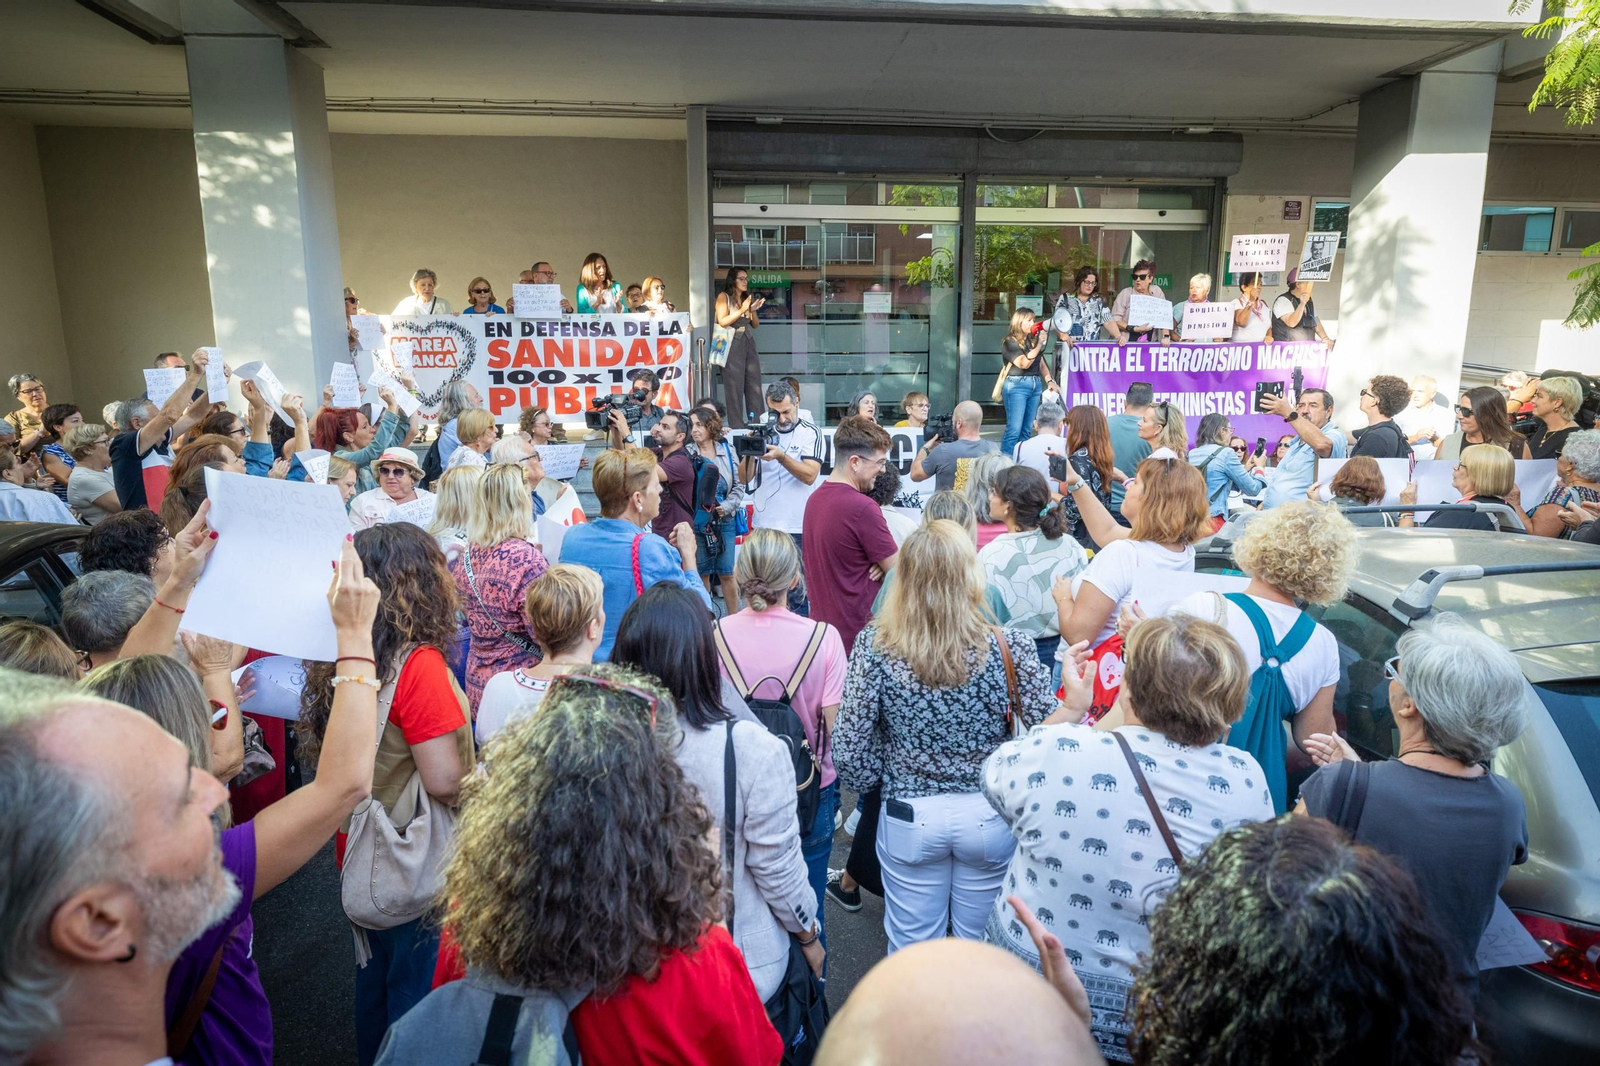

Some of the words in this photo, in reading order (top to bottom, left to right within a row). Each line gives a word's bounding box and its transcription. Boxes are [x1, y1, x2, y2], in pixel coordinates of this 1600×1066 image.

[751, 274, 782, 284] SALIDA
[1151, 277, 1169, 286] ADA
[484, 322, 513, 338] EN
[521, 321, 616, 337] DEFENSA
[624, 321, 651, 336] DE
[658, 320, 683, 335] LA
[392, 352, 458, 368] ANCA
[487, 338, 684, 369] SANIDAD
[1069, 346, 1121, 373] ONTRA
[1125, 346, 1145, 372] EL
[1149, 345, 1252, 373] TERRORISMO
[1257, 344, 1329, 370] MACHIST
[488, 369, 567, 385] 100
[572, 373, 603, 384] x
[488, 382, 683, 416] PÚBLA
[1072, 392, 1126, 416] MUJER
[505, 631, 528, 649] BIMBA
